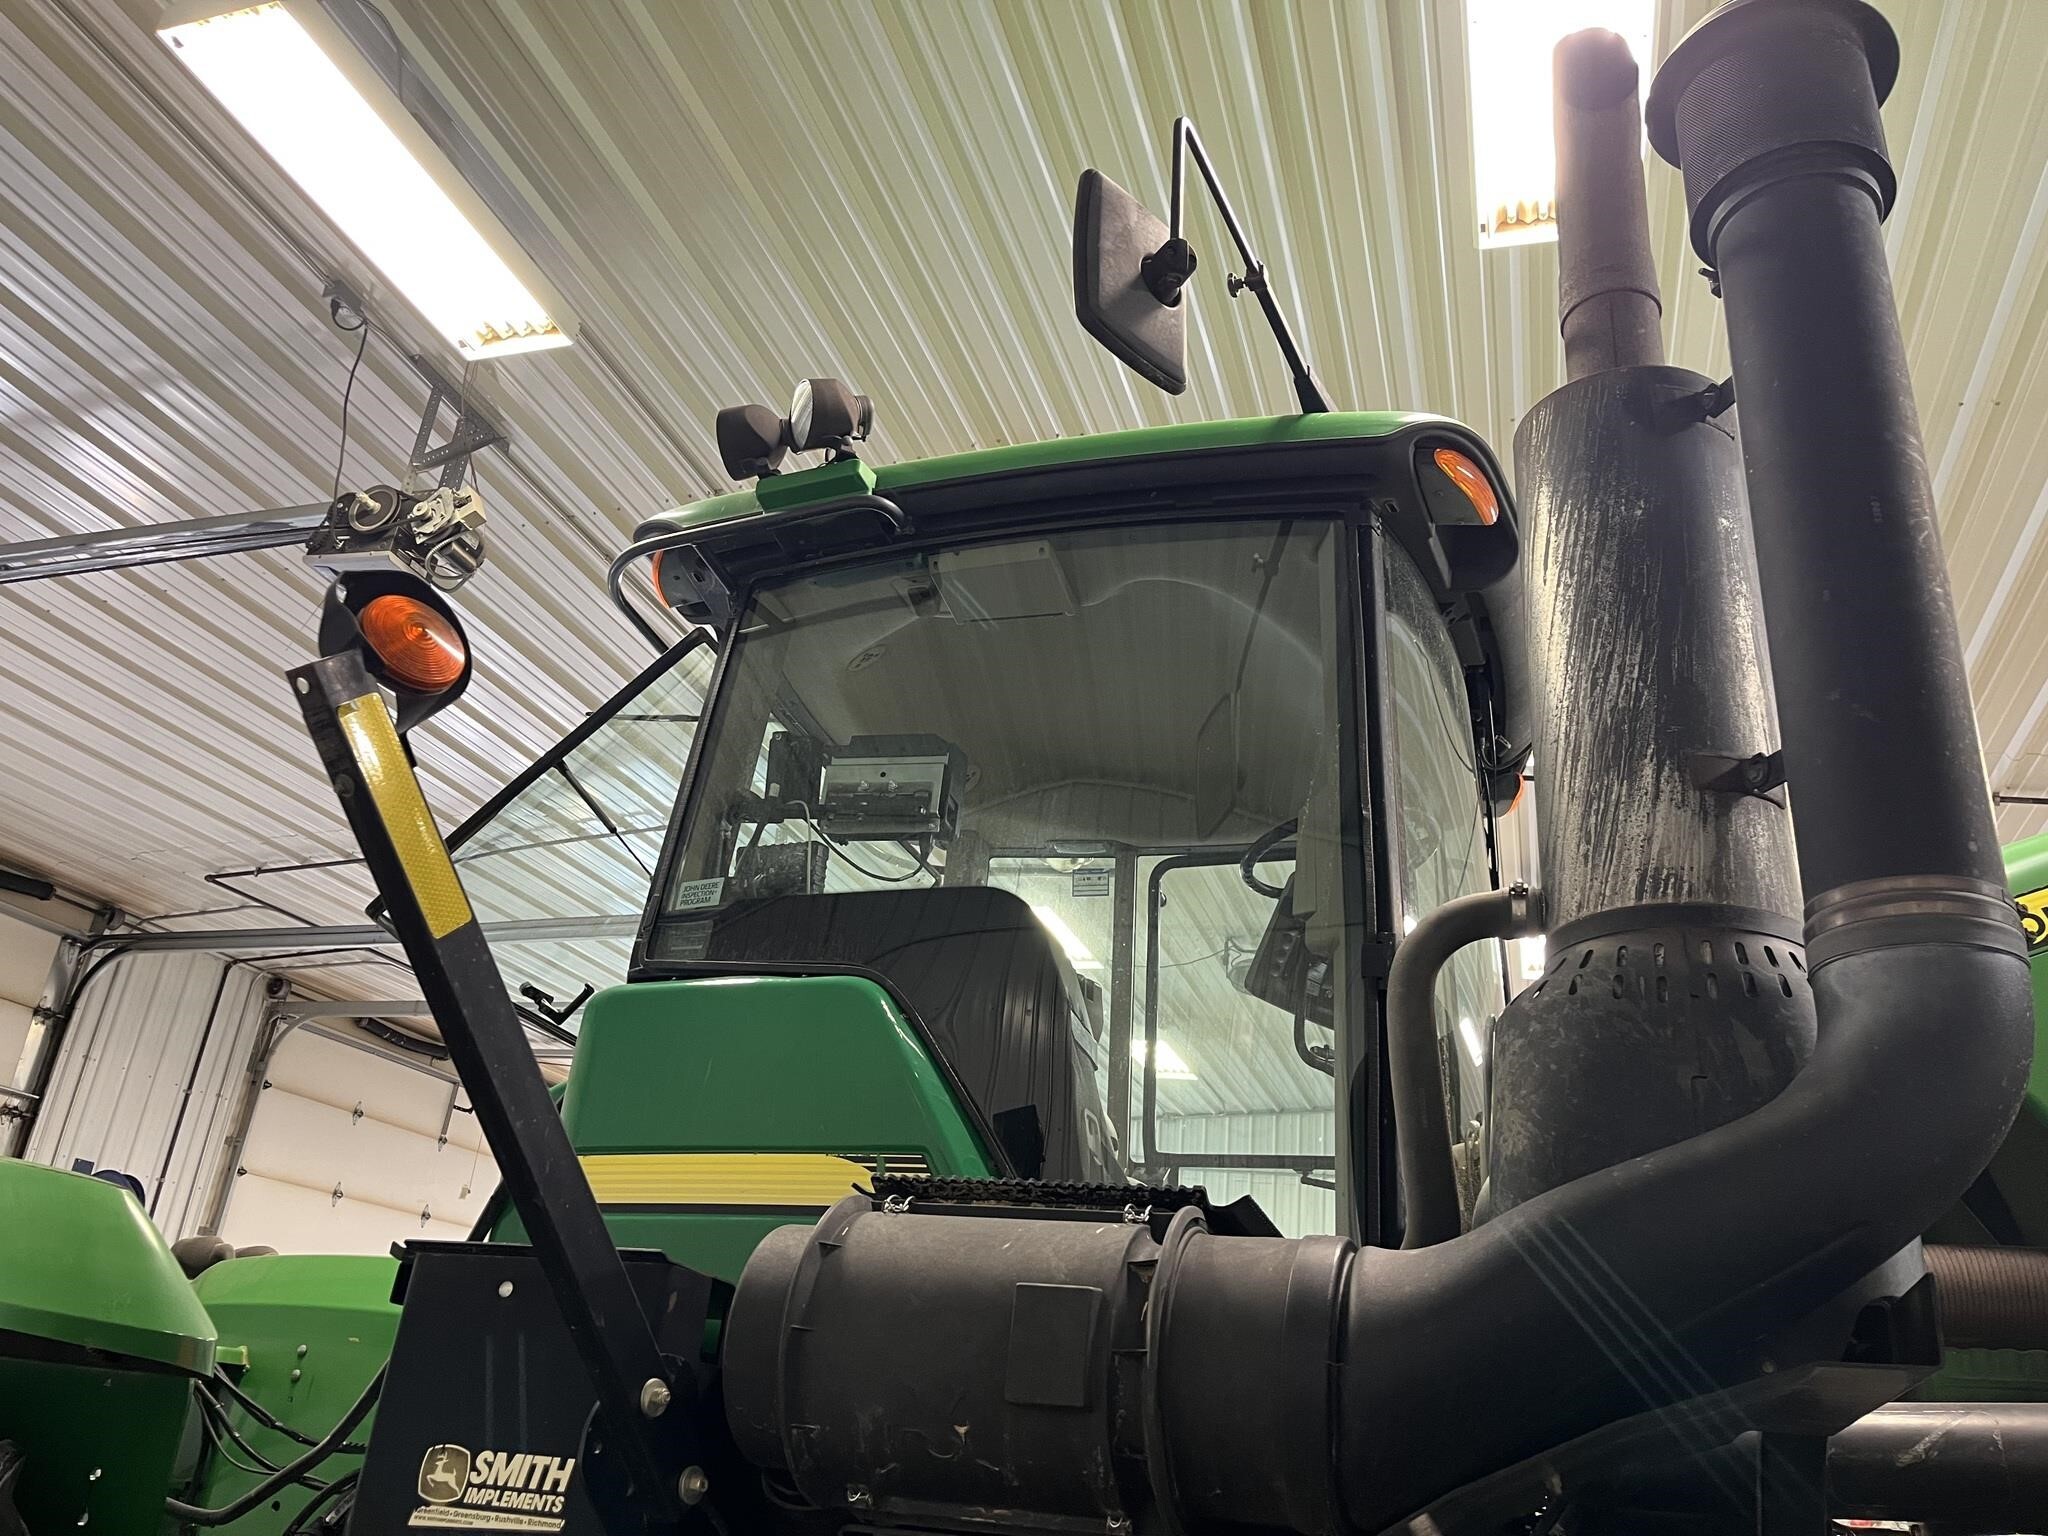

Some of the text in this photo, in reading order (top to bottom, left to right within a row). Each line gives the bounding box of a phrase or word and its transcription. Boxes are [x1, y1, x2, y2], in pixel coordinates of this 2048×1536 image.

[683, 881, 720, 893] JOHN DEERE
[680, 896, 711, 905] PROGRAM
[469, 1450, 576, 1492] SMITH
[463, 1487, 565, 1513] IMPLEMENTS
[453, 1510, 491, 1523] Greensburg
[494, 1515, 524, 1526] Rushville
[527, 1518, 561, 1529] Richmond
